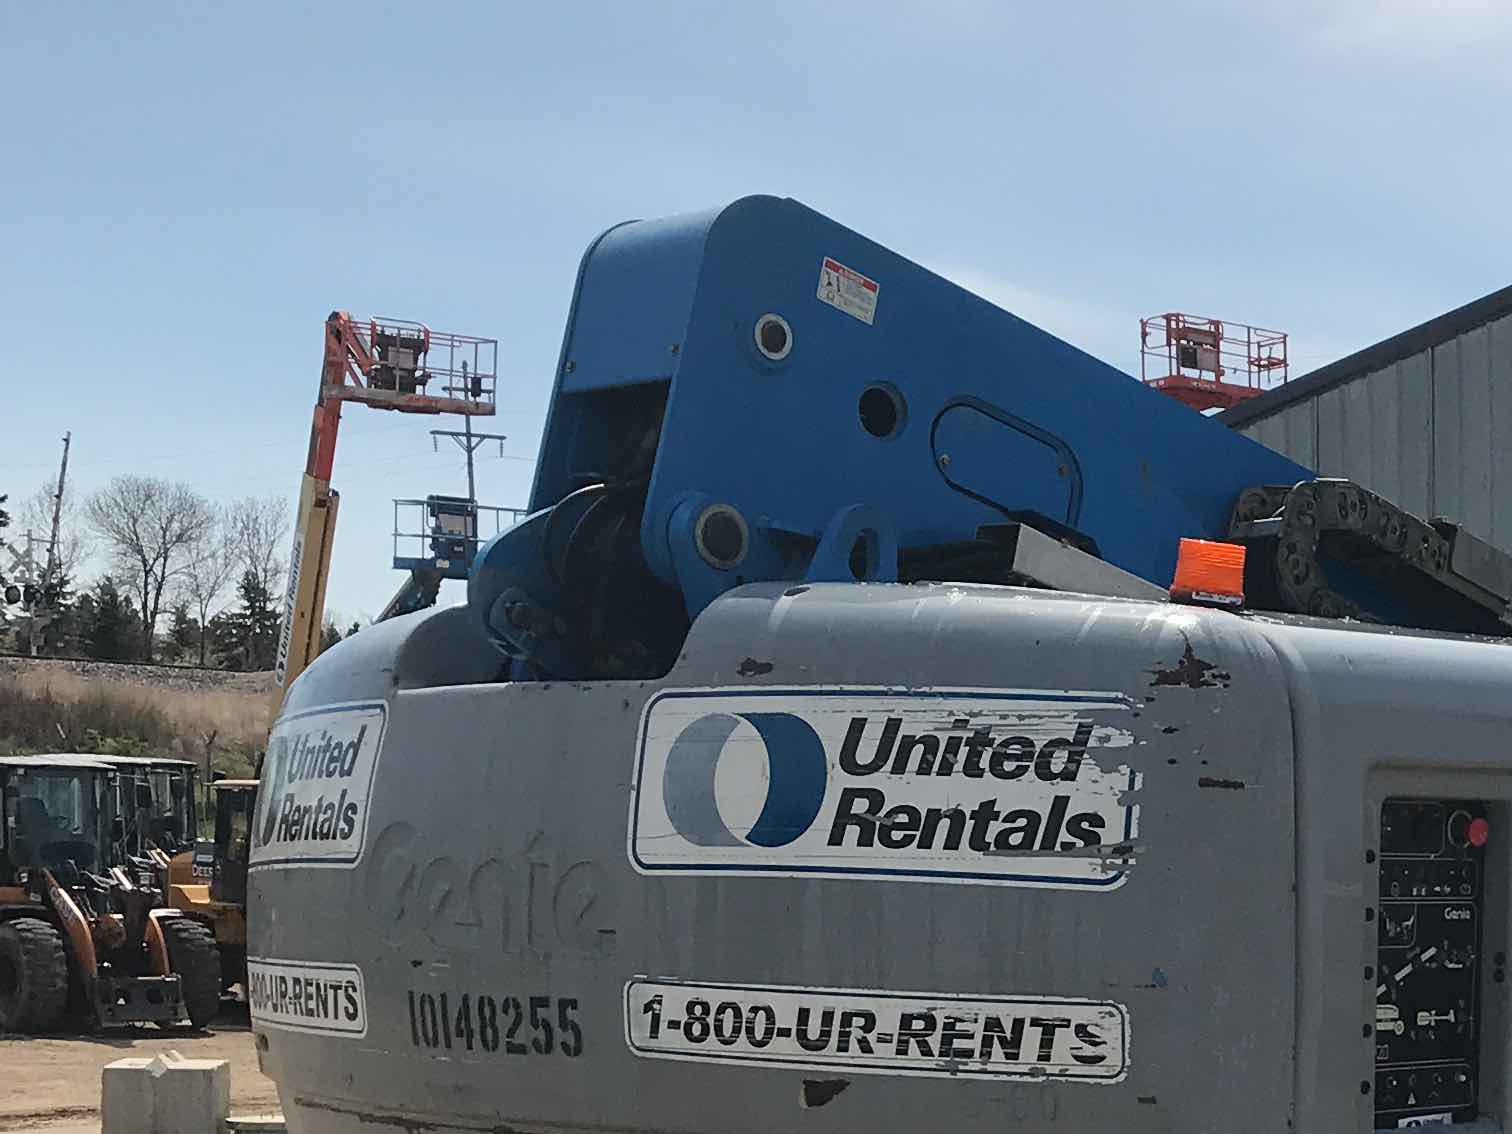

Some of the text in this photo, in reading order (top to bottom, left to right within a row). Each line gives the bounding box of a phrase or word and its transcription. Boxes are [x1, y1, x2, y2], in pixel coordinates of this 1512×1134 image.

[287, 724, 368, 784] United
[838, 716, 1094, 782] United
[277, 788, 358, 842] Rentals
[827, 787, 1106, 853] Rentals
[1444, 907, 1471, 920] Genie
[407, 990, 584, 1057] 10148255
[642, 993, 1107, 1065] 1-800-UR-RENTS
